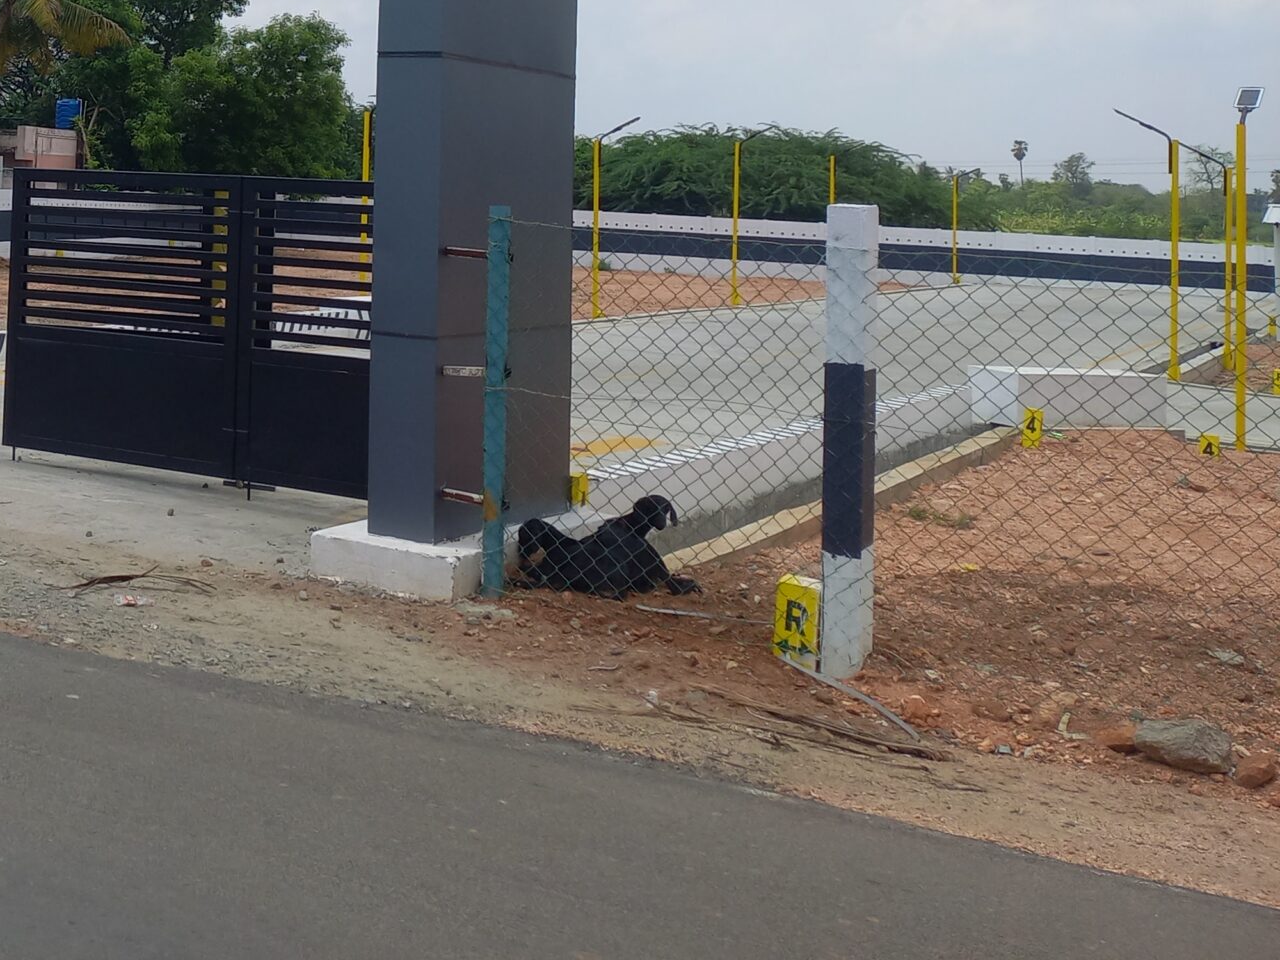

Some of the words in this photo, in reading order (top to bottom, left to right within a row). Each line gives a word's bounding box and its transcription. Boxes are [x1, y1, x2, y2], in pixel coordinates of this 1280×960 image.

[1026, 416, 1036, 433] 4
[1202, 441, 1215, 456] 4
[785, 599, 808, 636] R
